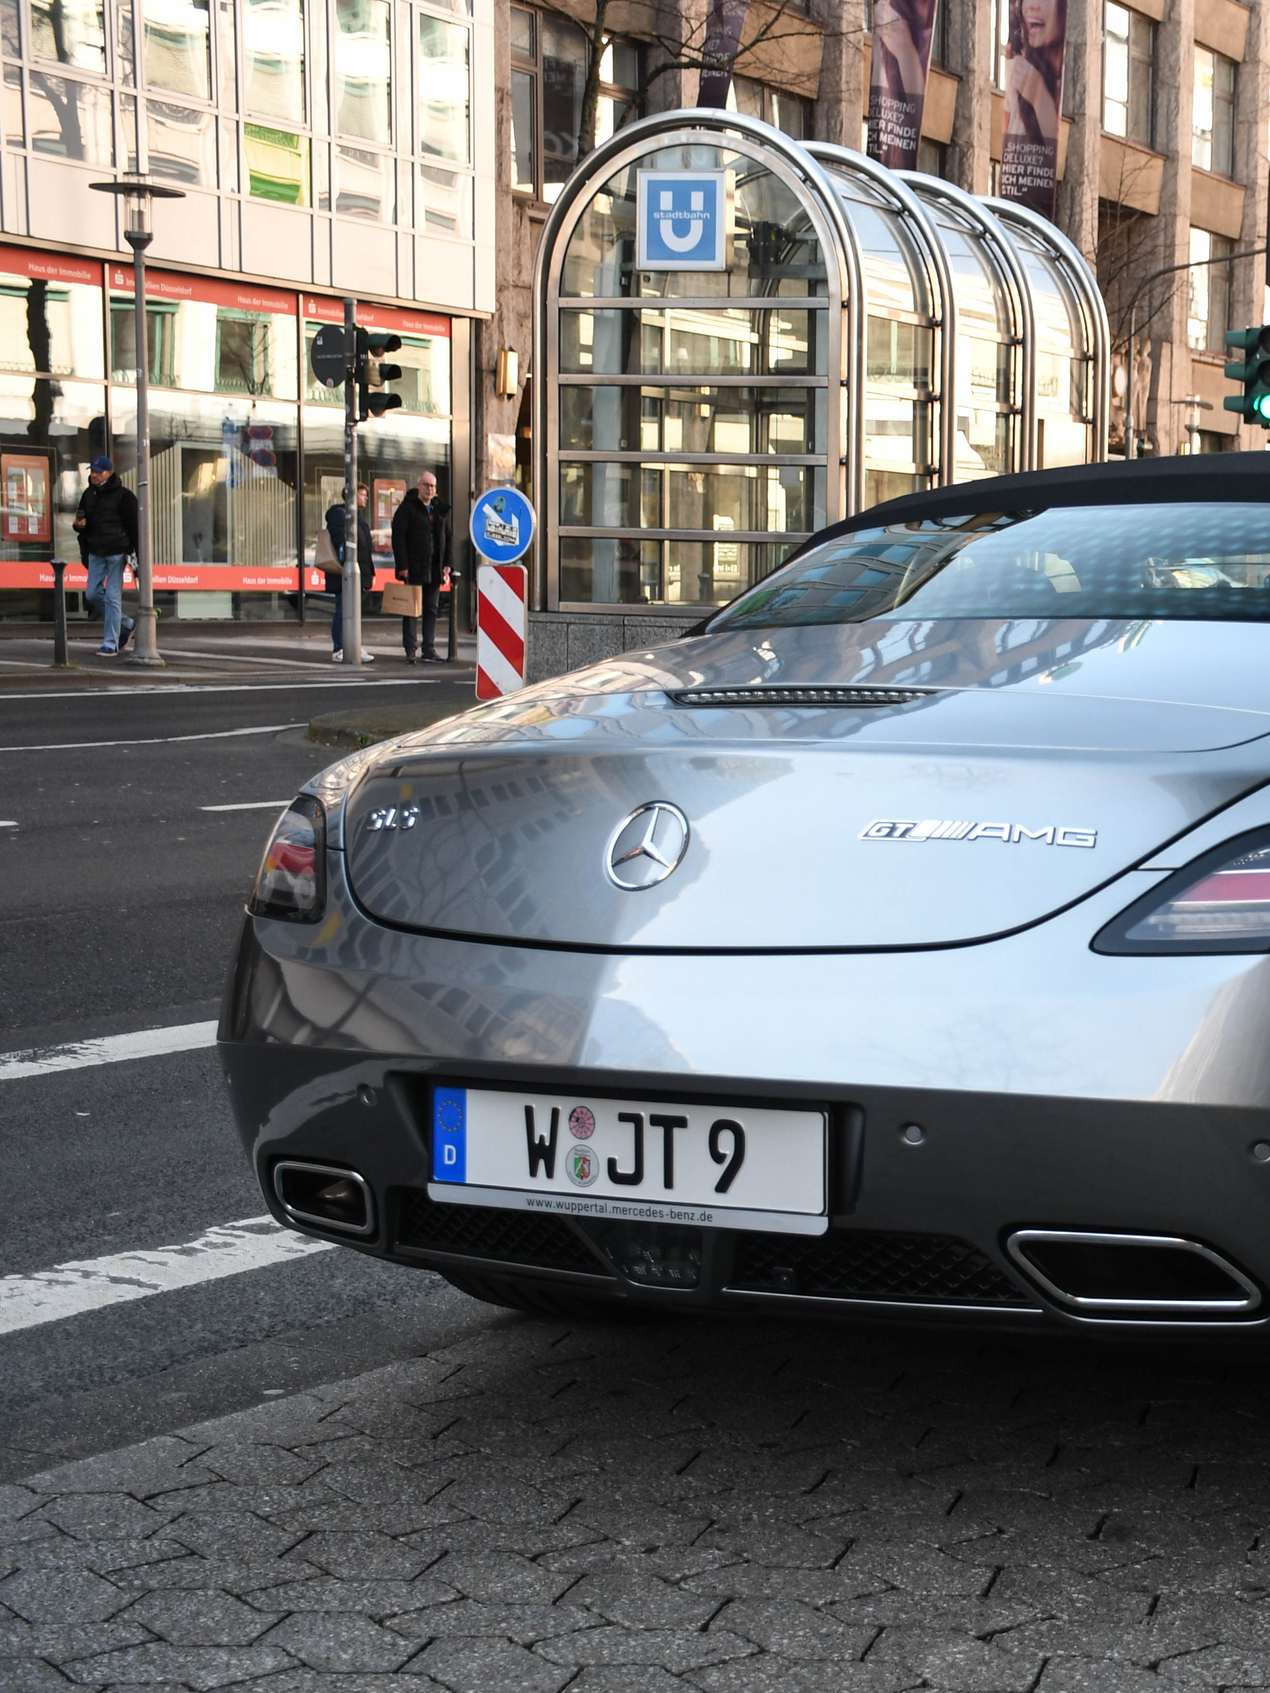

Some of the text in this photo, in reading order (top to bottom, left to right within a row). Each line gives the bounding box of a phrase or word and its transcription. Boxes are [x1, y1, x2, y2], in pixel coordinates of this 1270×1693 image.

[887, 122, 917, 138] FINDE
[879, 131, 917, 150] MEINEN
[1003, 153, 1044, 166] DELUXE?
[1002, 163, 1055, 178] HIER FINDE
[1001, 174, 1054, 188] ICH MEINEN
[653, 210, 710, 220] stadtbahn
[28, 262, 92, 280] Haus der Immobilie
[160, 283, 192, 295] Düsseldorf
[237, 295, 289, 310] Haus der Immobilie
[402, 319, 446, 332] Haus der Immobilie
[167, 575, 199, 584] Düsseldorf
[243, 576, 293, 586] Haus der Immobilie
[366, 806, 420, 830] SLS
[868, 822, 1098, 849] GT AMG
[443, 1144, 457, 1166] D
[525, 1104, 561, 1180] W
[708, 1118, 747, 1194] 9
[526, 1197, 714, 1223] www.wuppertal.mercedes-benz.de
